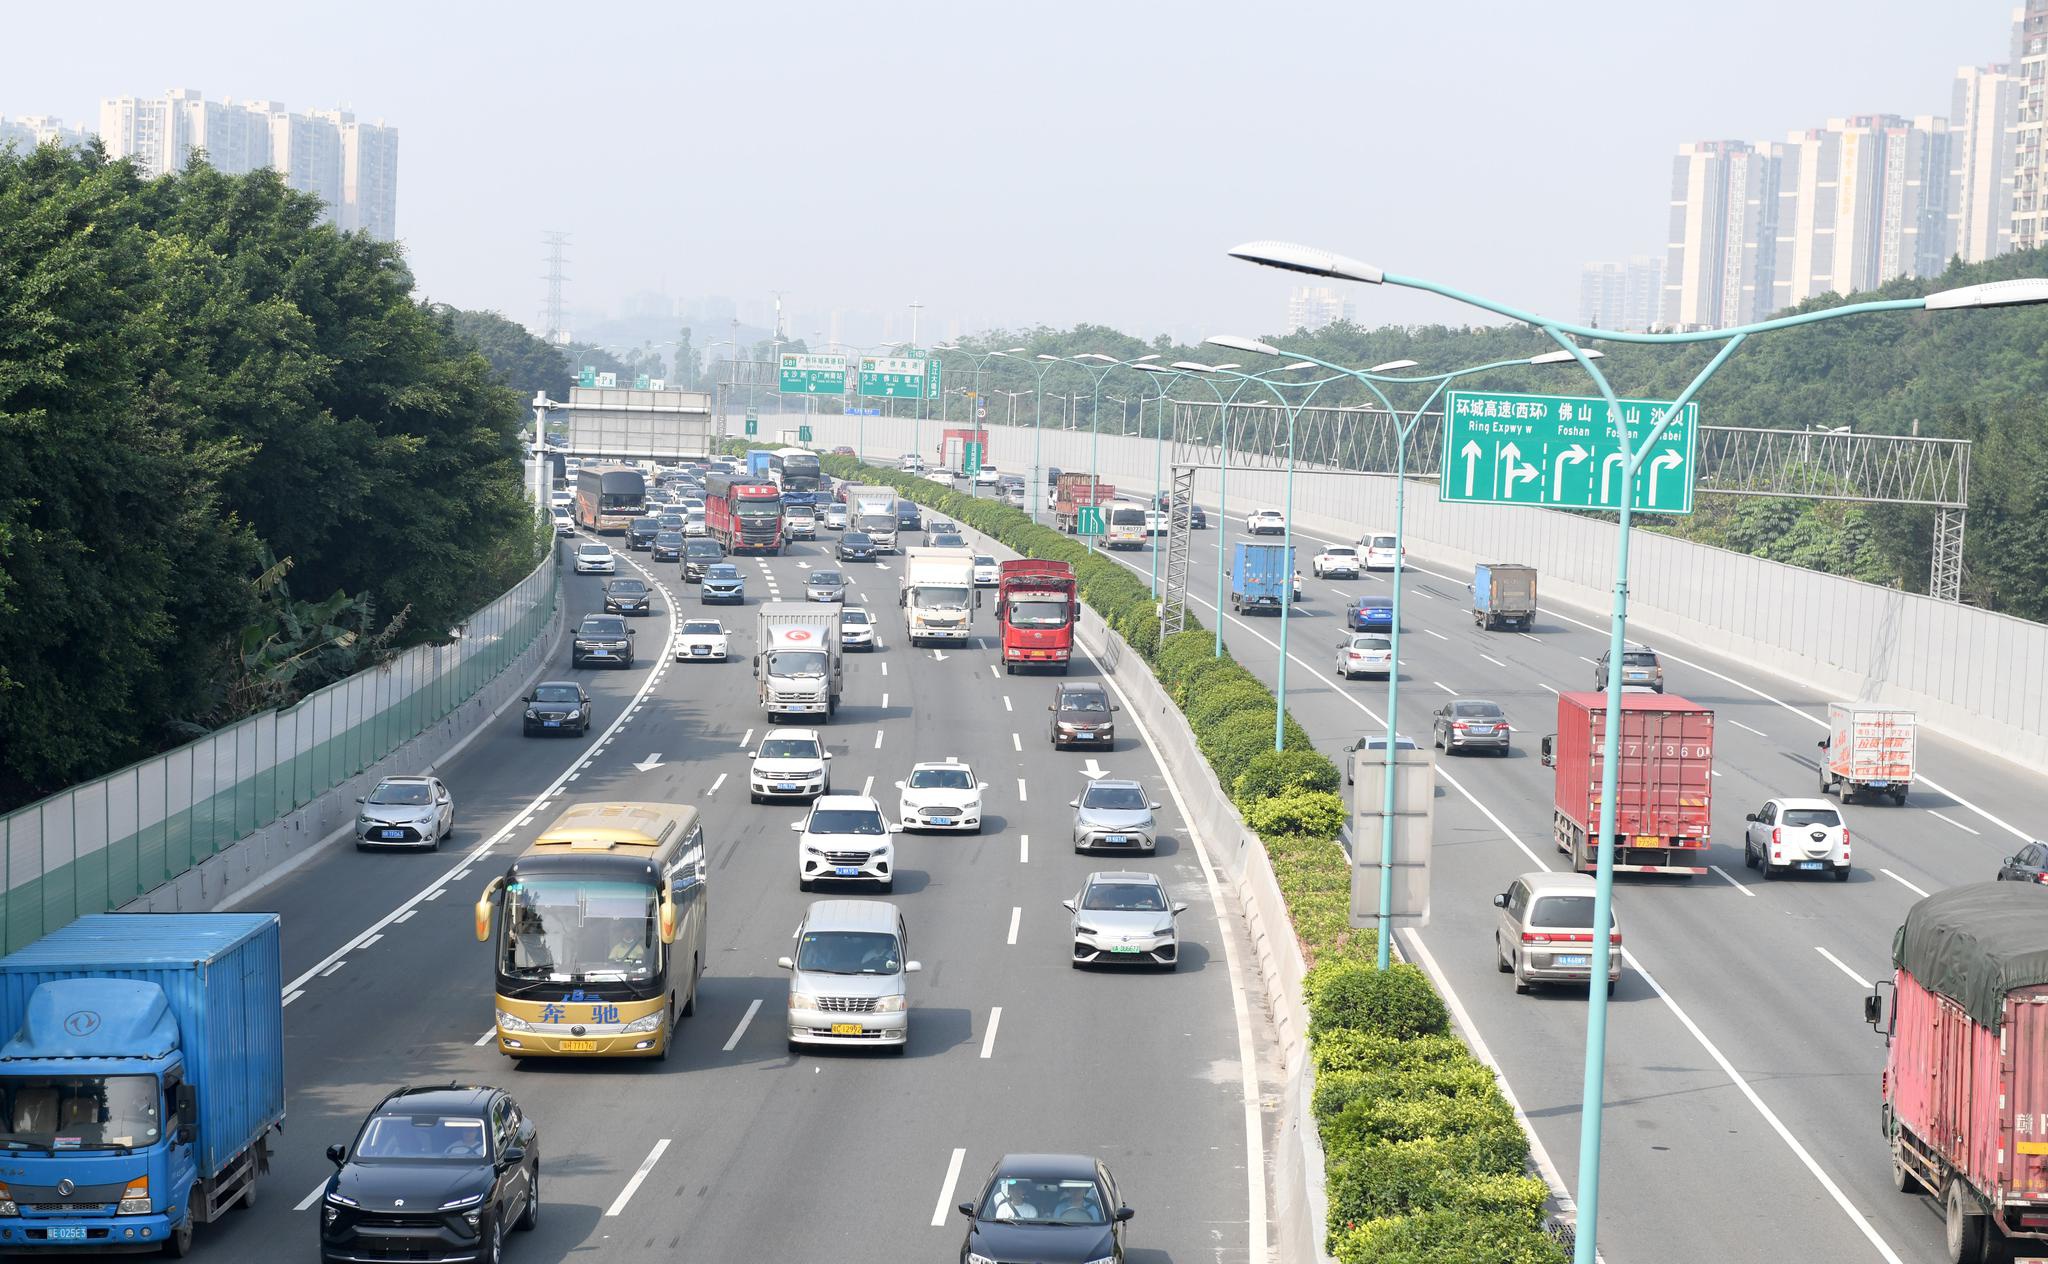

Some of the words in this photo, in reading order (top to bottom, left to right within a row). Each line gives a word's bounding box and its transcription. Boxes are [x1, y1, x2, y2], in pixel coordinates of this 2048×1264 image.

[1456, 399, 1548, 420] 环城高速(西环)
[1558, 402, 1592, 422] 佛山
[1469, 420, 1490, 434] Ring
[1492, 421, 1522, 435] Expwy
[1558, 424, 1590, 436] Foshan
[1606, 427, 1638, 439] Fosan
[537, 1003, 621, 1024] 奔驰
